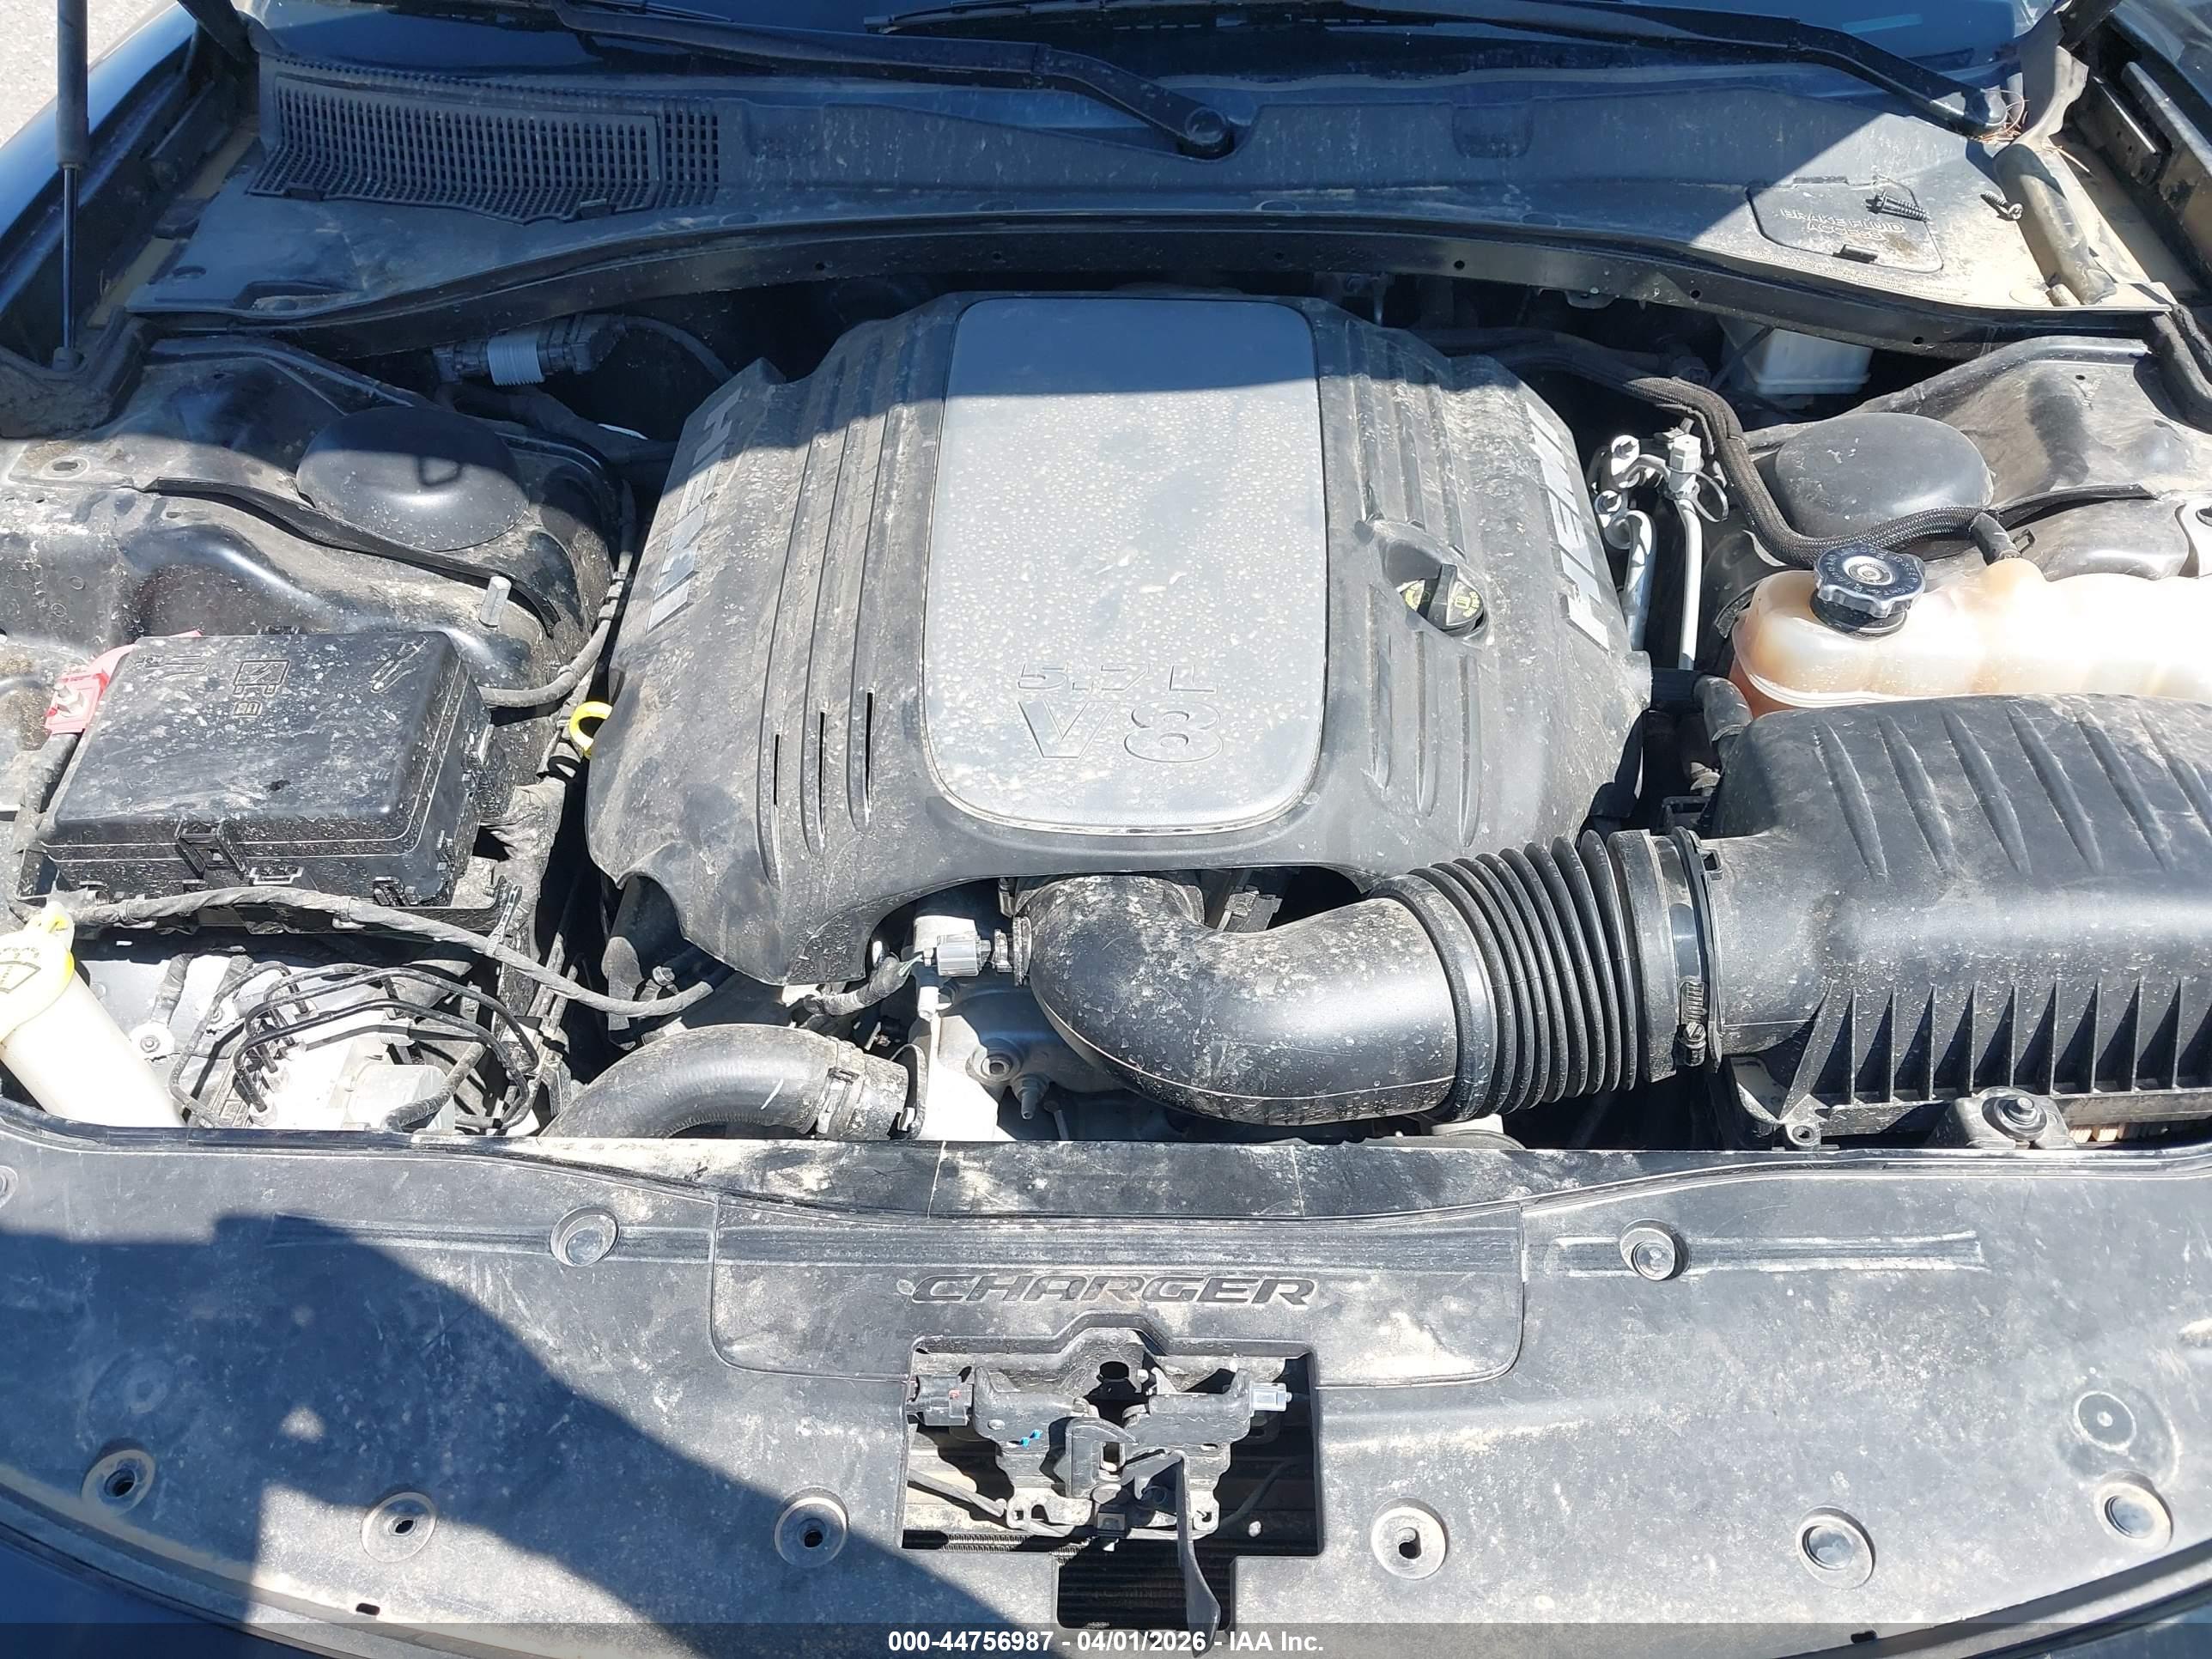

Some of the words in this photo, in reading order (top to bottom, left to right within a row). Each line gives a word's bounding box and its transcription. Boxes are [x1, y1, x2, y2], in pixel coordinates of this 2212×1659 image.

[1780, 209, 1845, 227] BRAKE
[1850, 216, 1905, 234] FLUID
[1808, 221, 1885, 241] ACCESS
[1018, 700, 1224, 763] V8
[912, 1274, 1316, 1306] CHARGER
